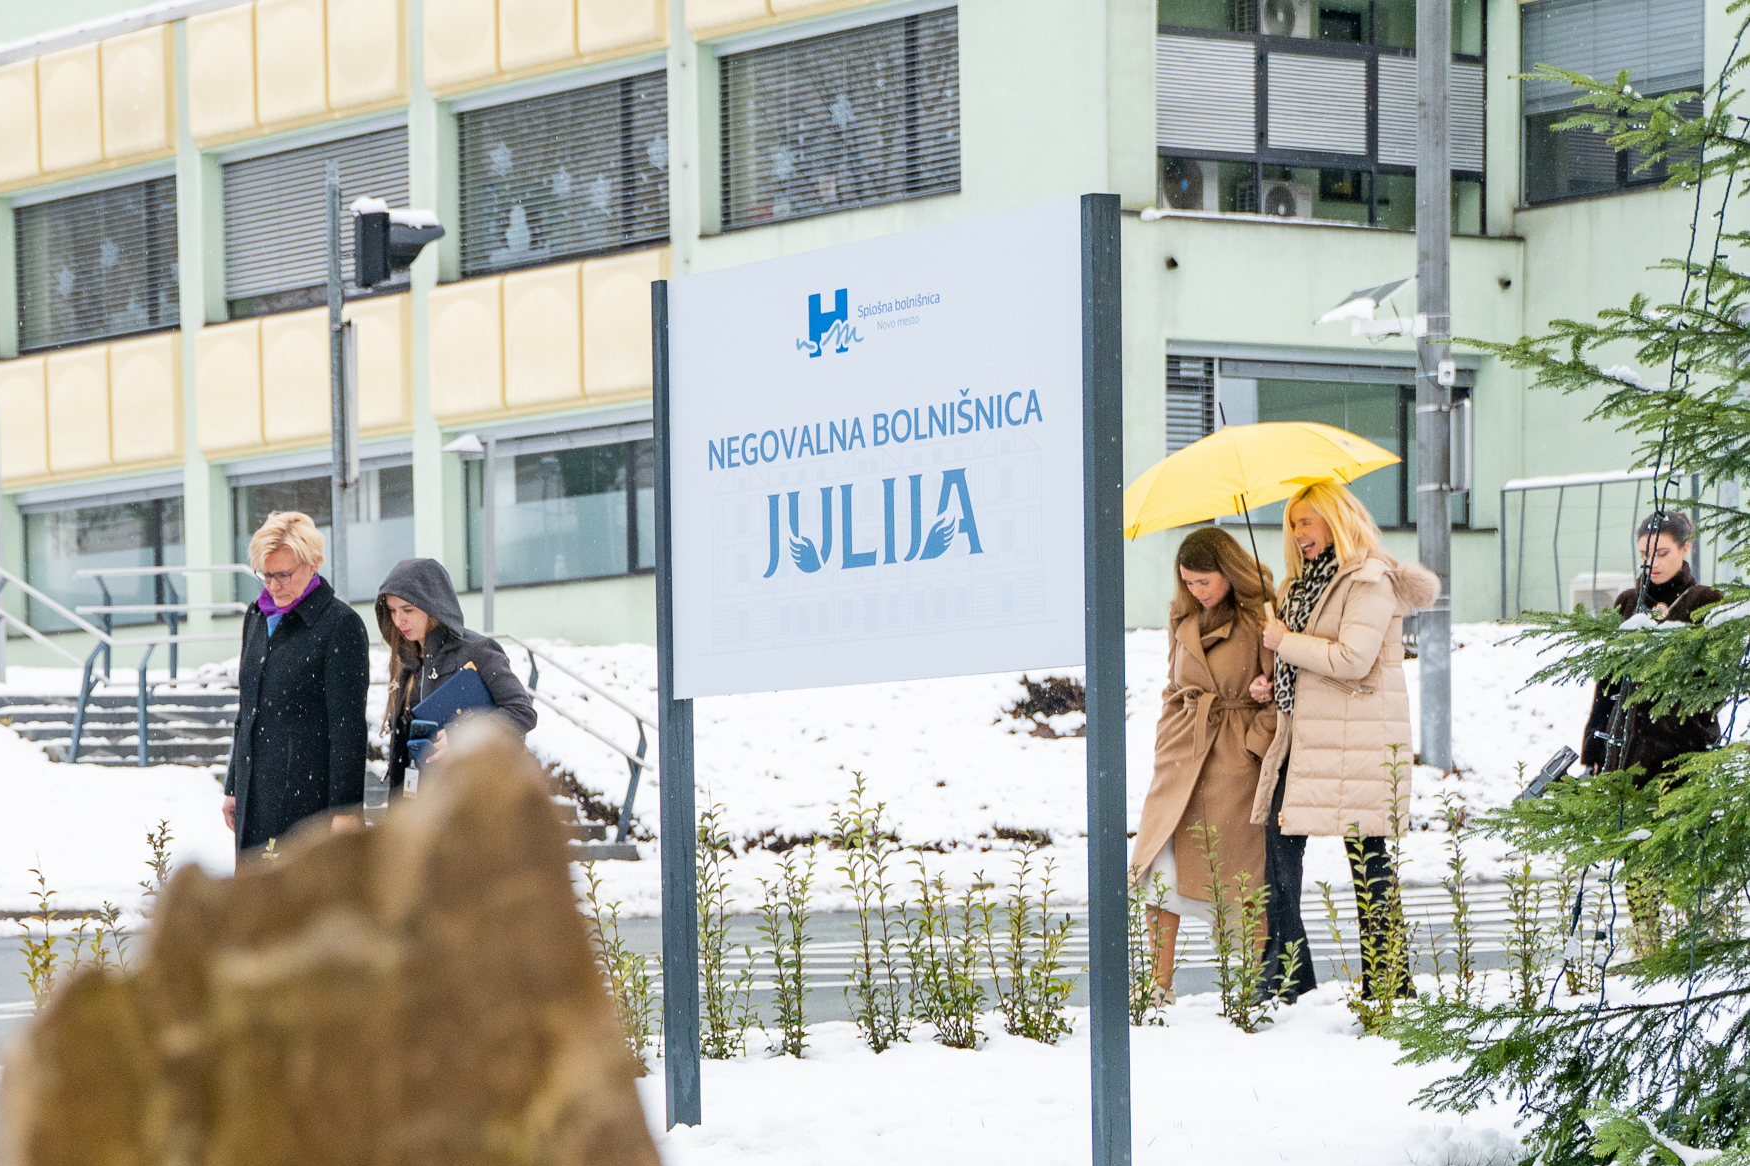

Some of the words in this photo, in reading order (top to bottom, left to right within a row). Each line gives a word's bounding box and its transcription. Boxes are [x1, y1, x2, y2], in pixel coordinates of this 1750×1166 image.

[858, 301, 893, 320] Splošna
[895, 293, 940, 311] bolnišnica
[877, 320, 896, 331] Novo
[897, 315, 920, 327] mesto
[709, 417, 866, 471] NEGOVALNA
[873, 388, 1043, 447] BOLNIŠNICA
[763, 468, 985, 579] JULIJA
